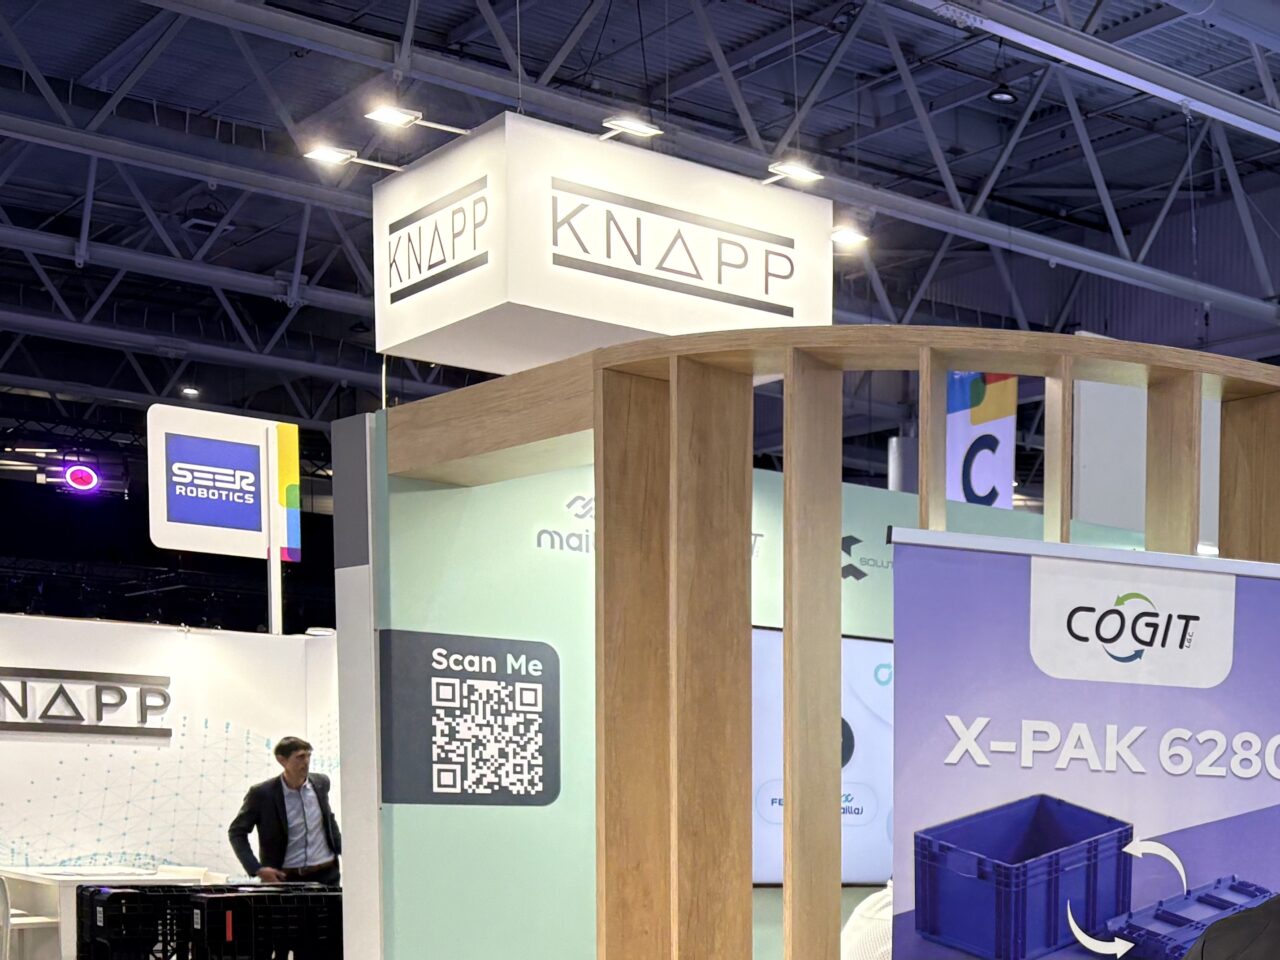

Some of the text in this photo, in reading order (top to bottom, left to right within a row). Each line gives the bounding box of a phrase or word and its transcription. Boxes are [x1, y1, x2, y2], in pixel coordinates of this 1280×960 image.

[389, 196, 488, 288] KNAPP
[551, 195, 795, 296] KNAPP
[171, 462, 256, 492] SEER
[962, 433, 1000, 508] C
[175, 485, 255, 504] ROBOTICS
[536, 528, 596, 554] mai
[1066, 606, 1201, 650] COGIT
[431, 647, 543, 677] Scan Me
[943, 715, 1148, 775] X-PAK
